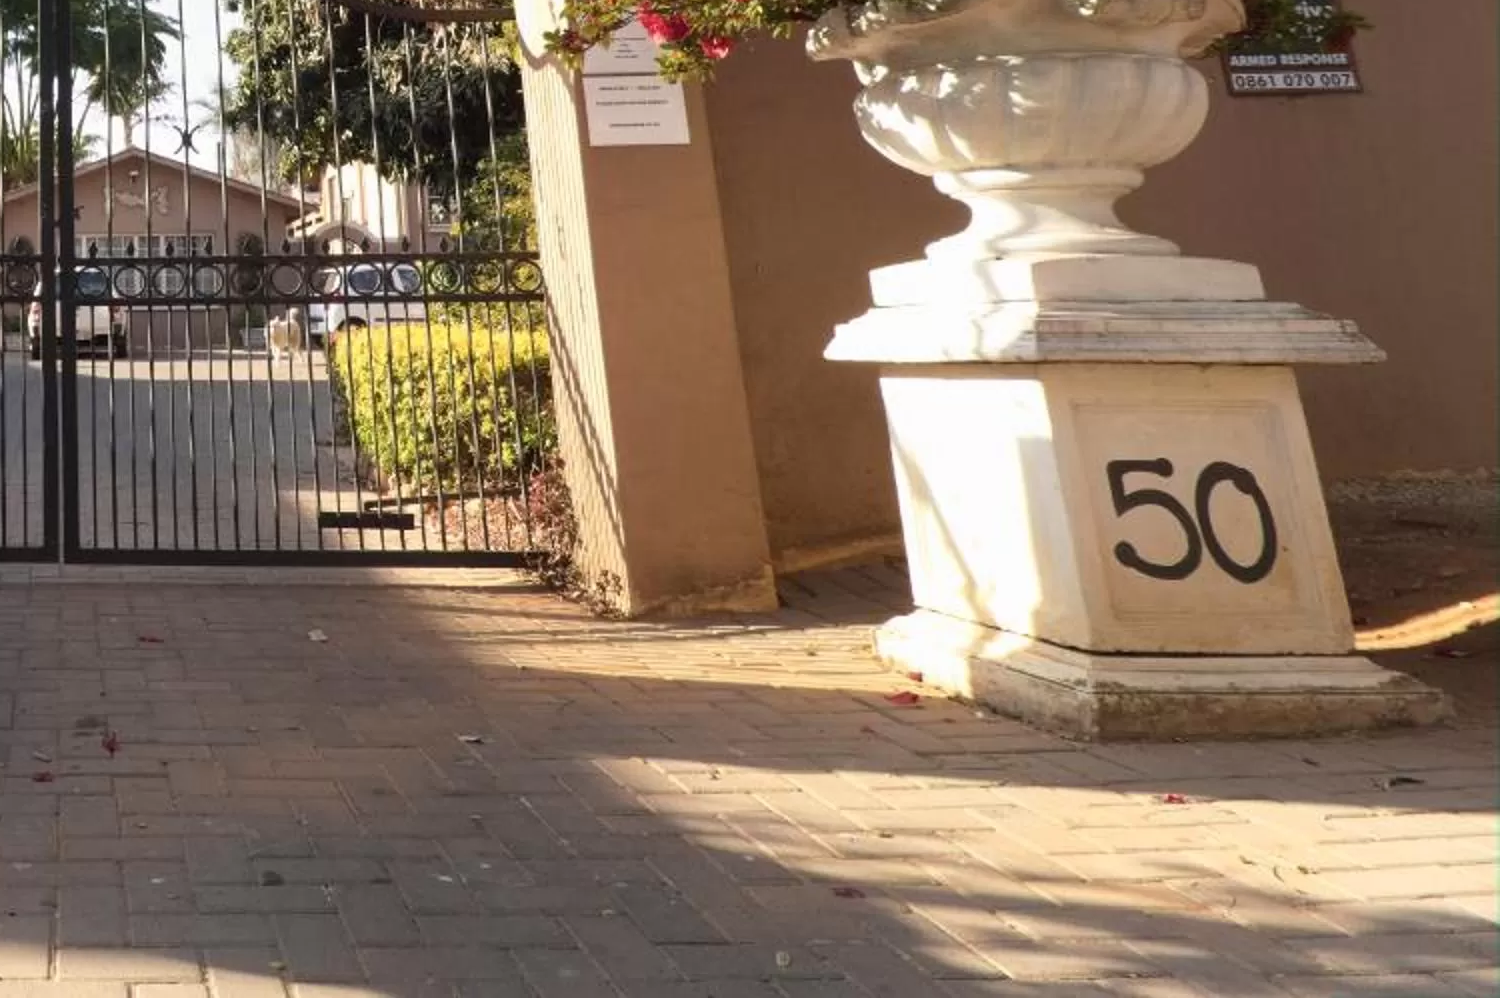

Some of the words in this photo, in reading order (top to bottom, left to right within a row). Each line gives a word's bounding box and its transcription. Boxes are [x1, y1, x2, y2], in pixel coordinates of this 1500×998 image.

[1230, 54, 1277, 67] ARMED
[1280, 53, 1349, 65] RESPONSE
[1235, 74, 1277, 87] 0861
[1283, 73, 1315, 87] 070
[1320, 72, 1350, 86] 007
[1107, 458, 1277, 584] 50
